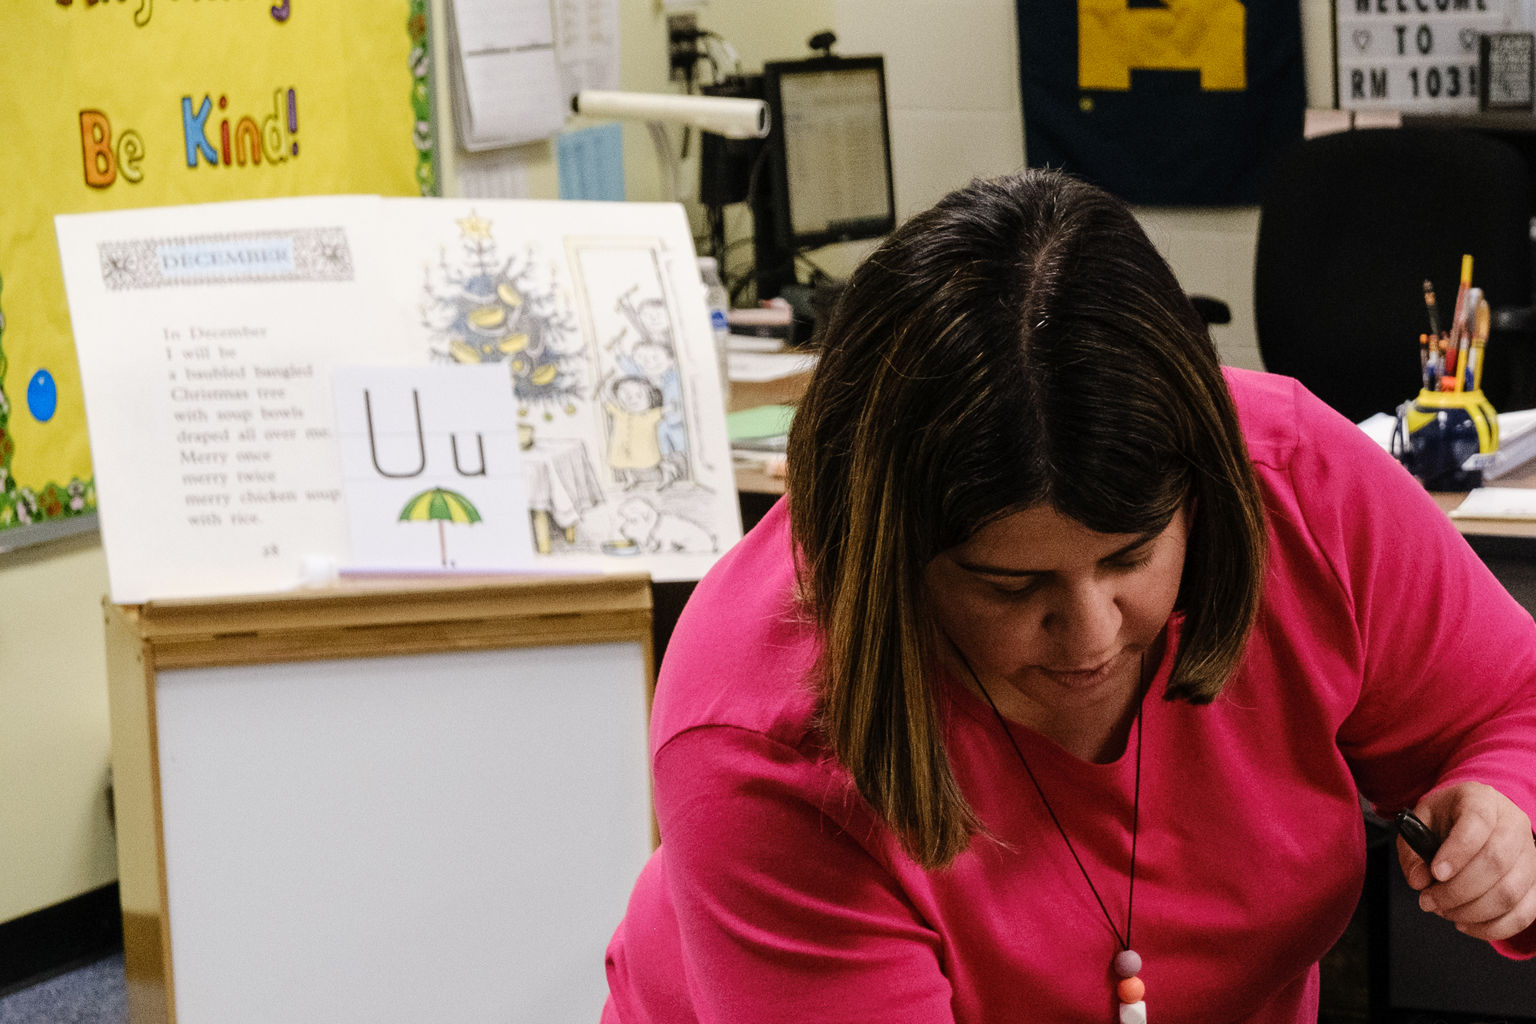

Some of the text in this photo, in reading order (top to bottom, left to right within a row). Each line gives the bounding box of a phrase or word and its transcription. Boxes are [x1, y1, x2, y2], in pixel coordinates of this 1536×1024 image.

[1394, 24, 1432, 55] TO
[1351, 66, 1478, 98] RM 103!
[79, 88, 299, 189] Be Kind!
[161, 247, 289, 269] DECEMBER
[162, 326, 268, 340] In December
[182, 346, 210, 359] will
[218, 346, 236, 357] be
[171, 387, 285, 401] Christmas tree
[174, 405, 304, 426] with soup bowls
[177, 429, 229, 444] draped
[238, 428, 256, 441] all
[264, 431, 297, 440] over
[180, 451, 271, 464] Merry once
[182, 471, 276, 487] merry twice
[185, 490, 341, 508] merry chicken soup
[188, 513, 221, 526] with
